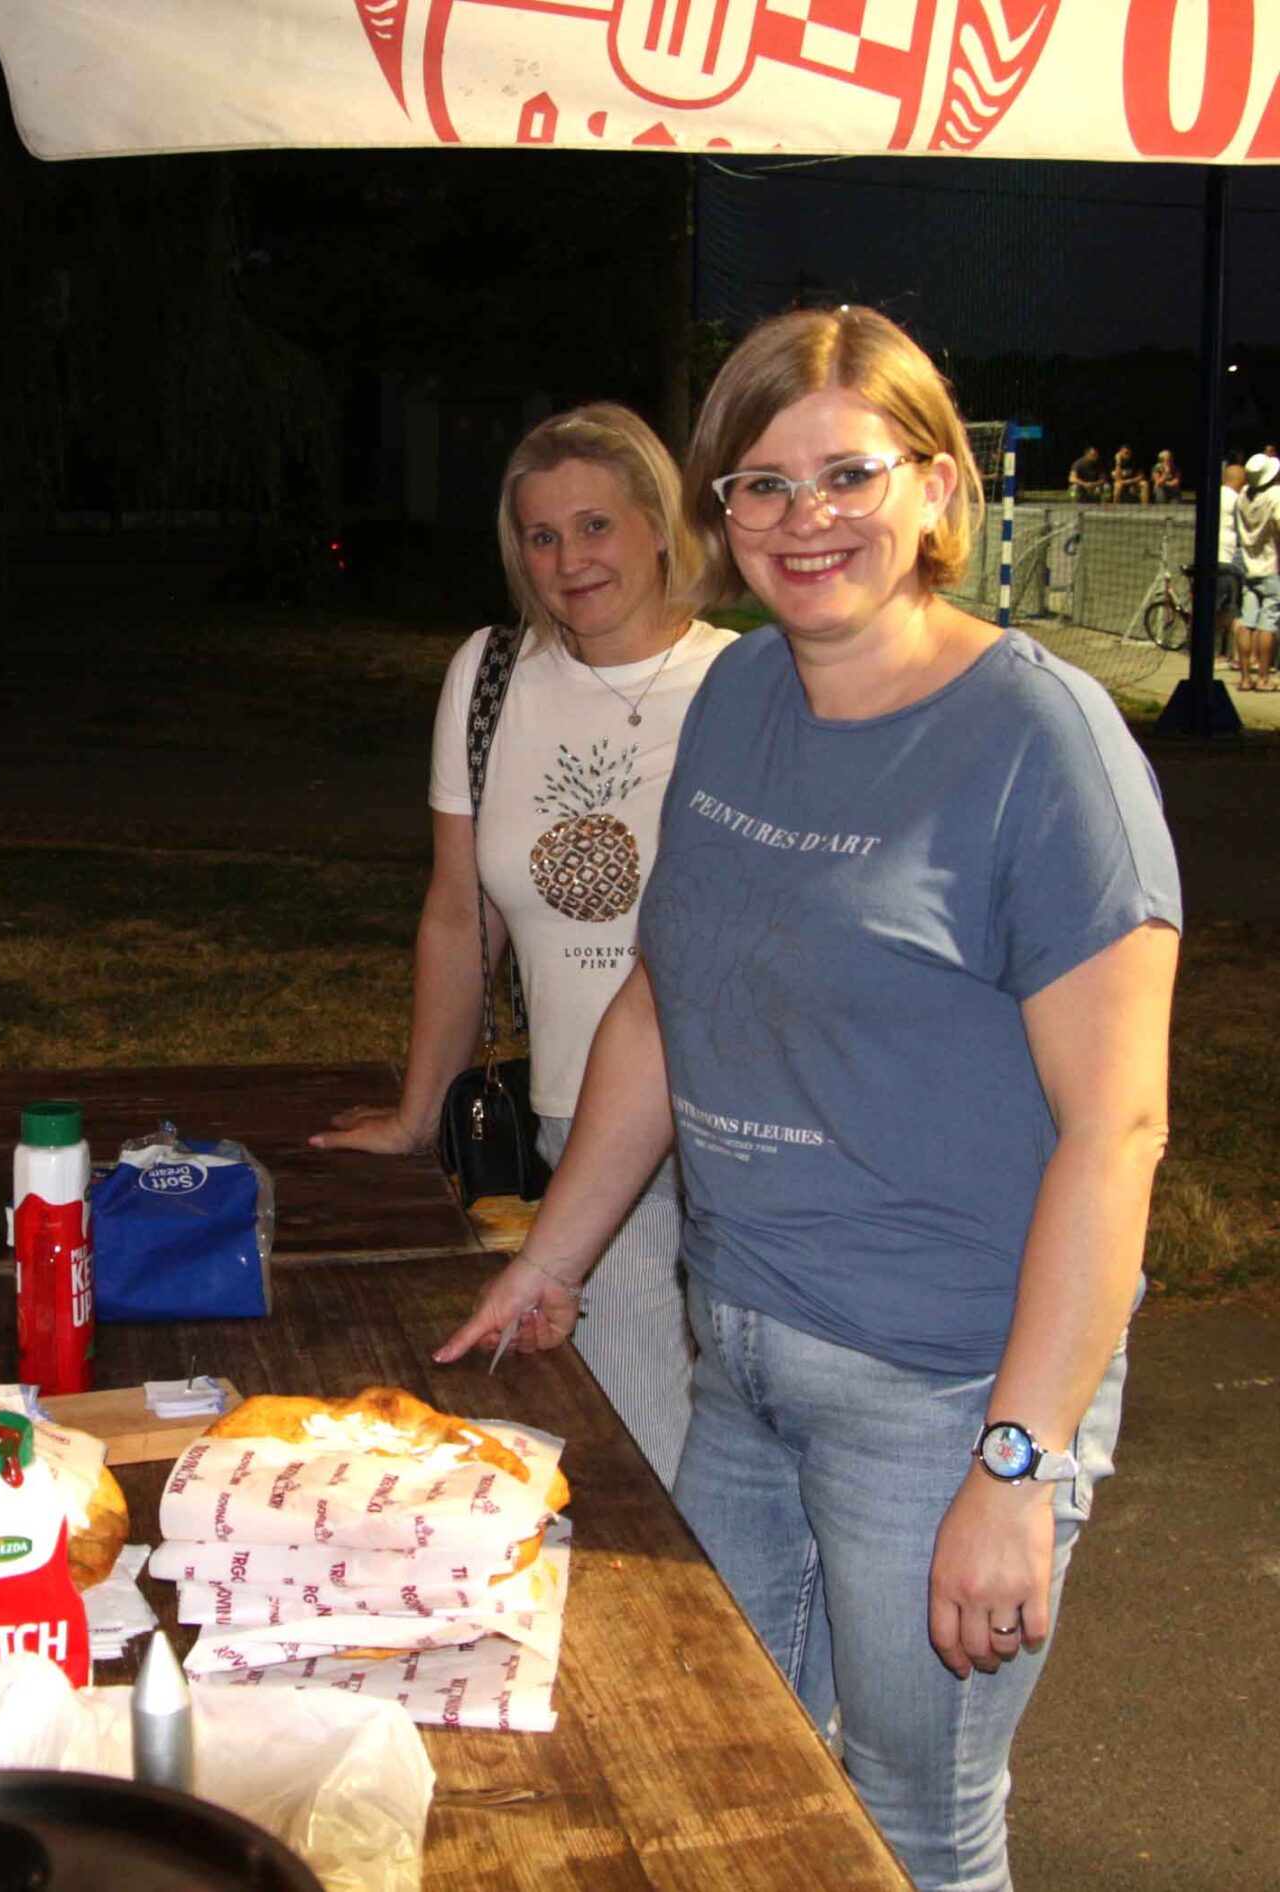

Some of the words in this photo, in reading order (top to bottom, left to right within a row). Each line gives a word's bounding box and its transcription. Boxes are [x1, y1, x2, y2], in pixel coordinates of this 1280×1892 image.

[689, 789, 799, 850] PEINTURES
[564, 946, 637, 958] LOOKING
[742, 1121, 823, 1146] FLEURIES
[149, 1165, 190, 1177] Dream
[151, 1175, 194, 1190] Soft
